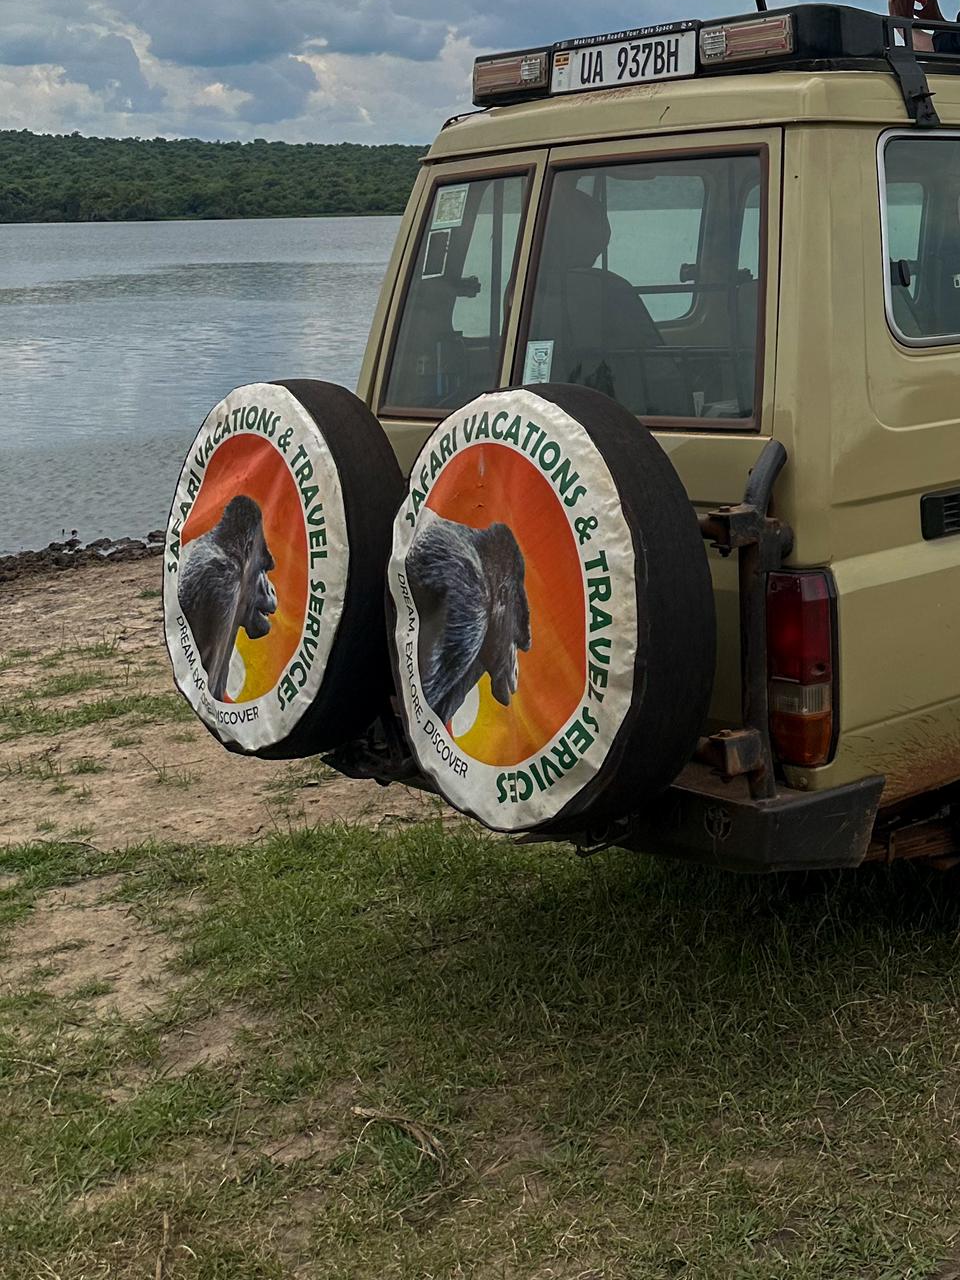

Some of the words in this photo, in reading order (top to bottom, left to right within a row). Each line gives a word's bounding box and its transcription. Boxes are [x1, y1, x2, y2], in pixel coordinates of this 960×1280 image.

[573, 37, 595, 46] Making
[596, 34, 606, 42] the
[626, 29, 639, 37] Your
[640, 27, 654, 35] Safe
[655, 24, 674, 32] Space
[580, 51, 603, 84] UA
[617, 39, 680, 80] 937BH
[195, 405, 281, 469] VACATIONS
[278, 427, 294, 454] &
[463, 411, 587, 507] VACATIONS
[167, 468, 202, 573] SAFARI
[290, 444, 328, 569] TRAVEL
[574, 516, 598, 545] &
[277, 579, 326, 711] SERVICES
[585, 550, 612, 703] TRAVEL
[423, 720, 469, 778] DISCOVER
[496, 706, 600, 804] SERVICES
